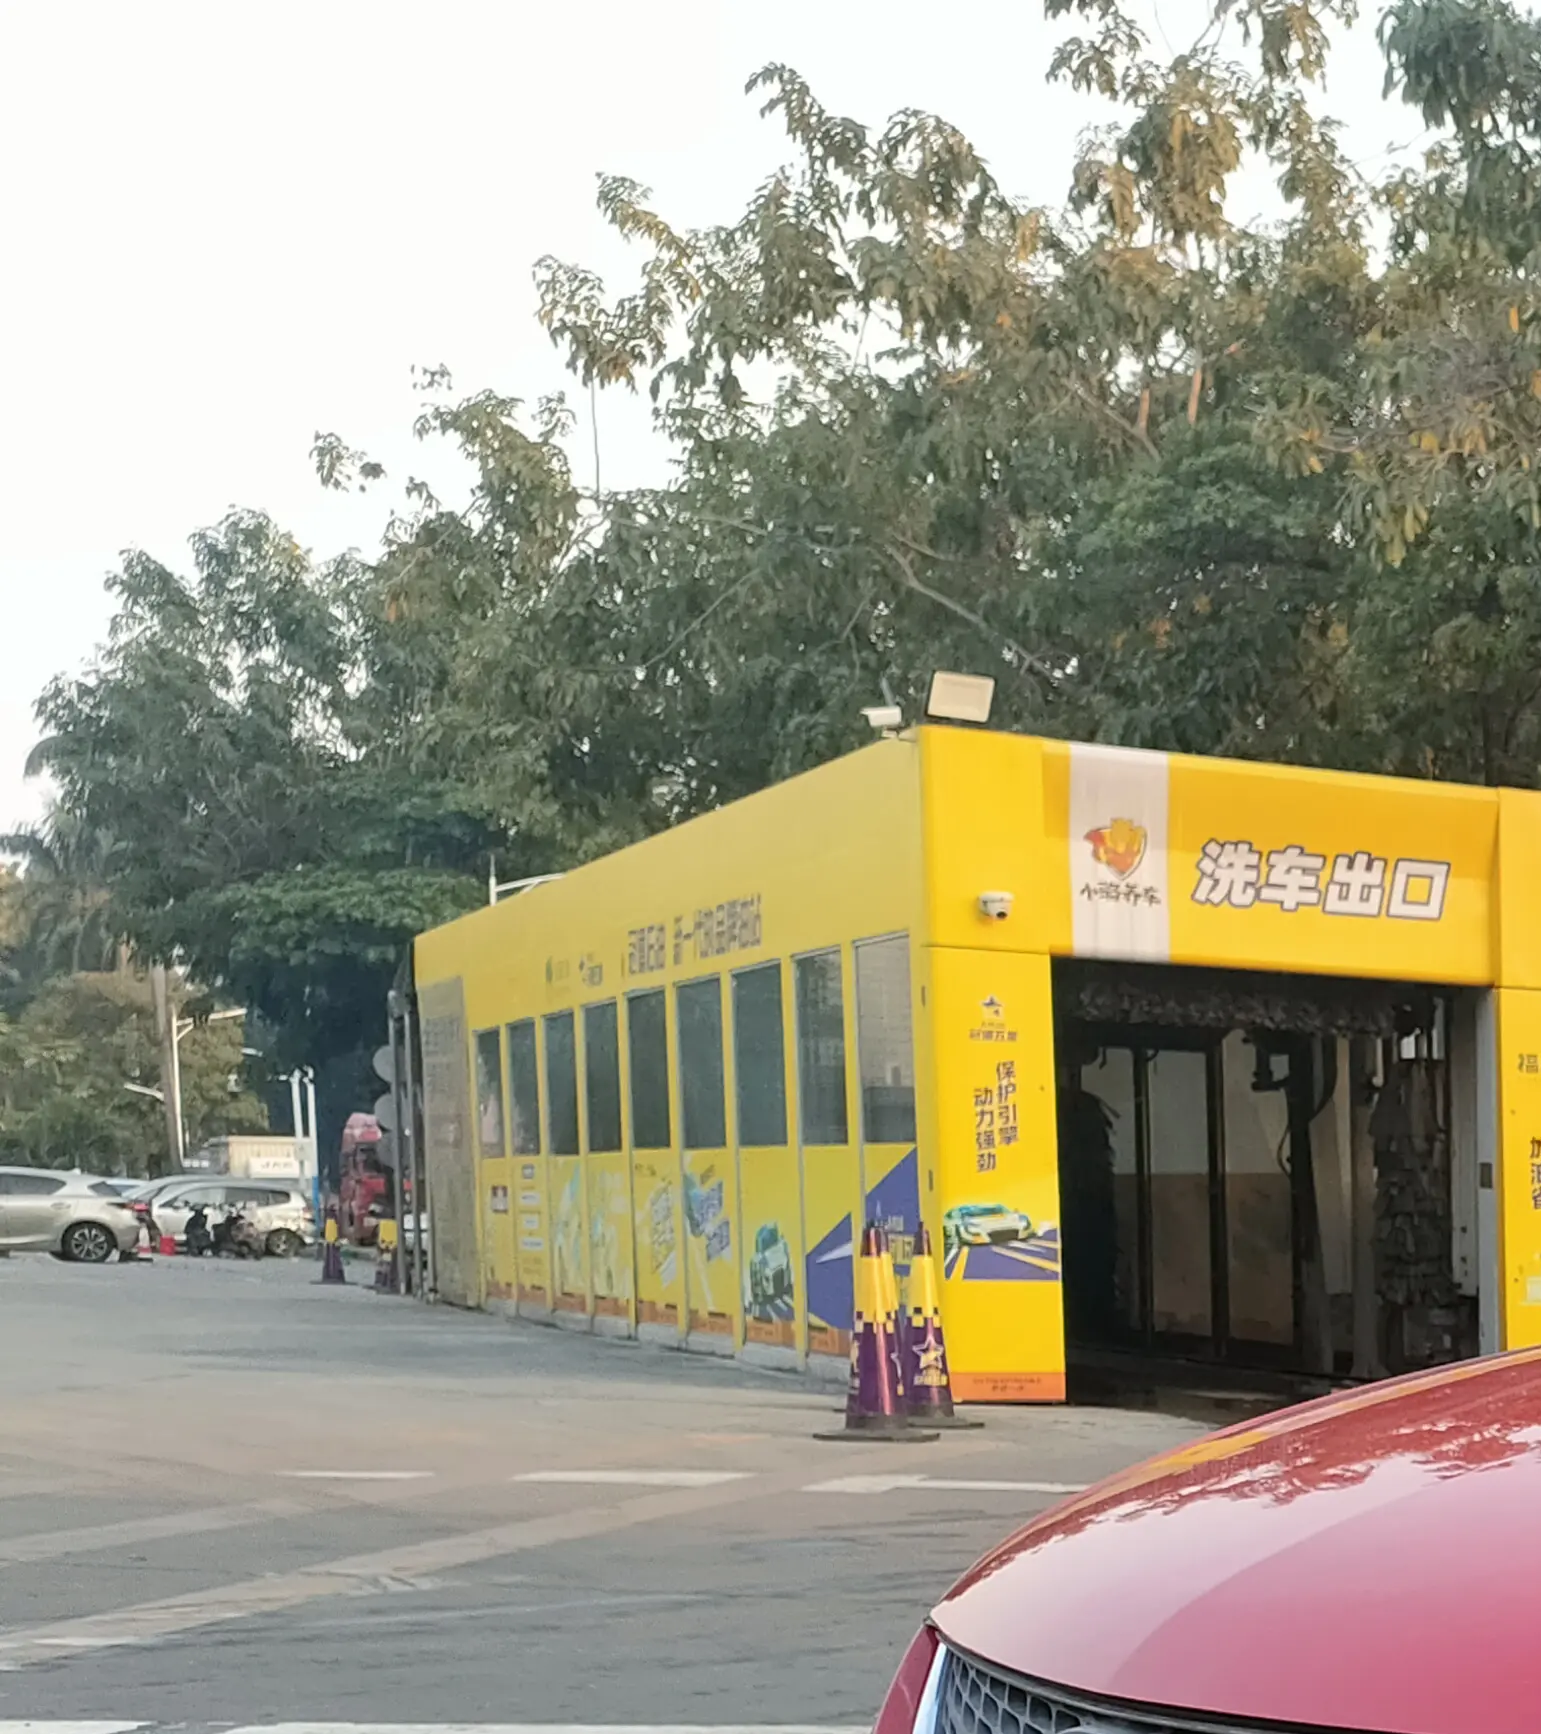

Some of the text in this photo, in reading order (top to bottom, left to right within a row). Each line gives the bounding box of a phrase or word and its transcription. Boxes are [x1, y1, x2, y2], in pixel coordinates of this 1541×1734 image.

[1191, 838, 1451, 920] 洗车出口
[974, 1086, 996, 1173] 动力强劲
[996, 1060, 1019, 1146] 保护引擎
